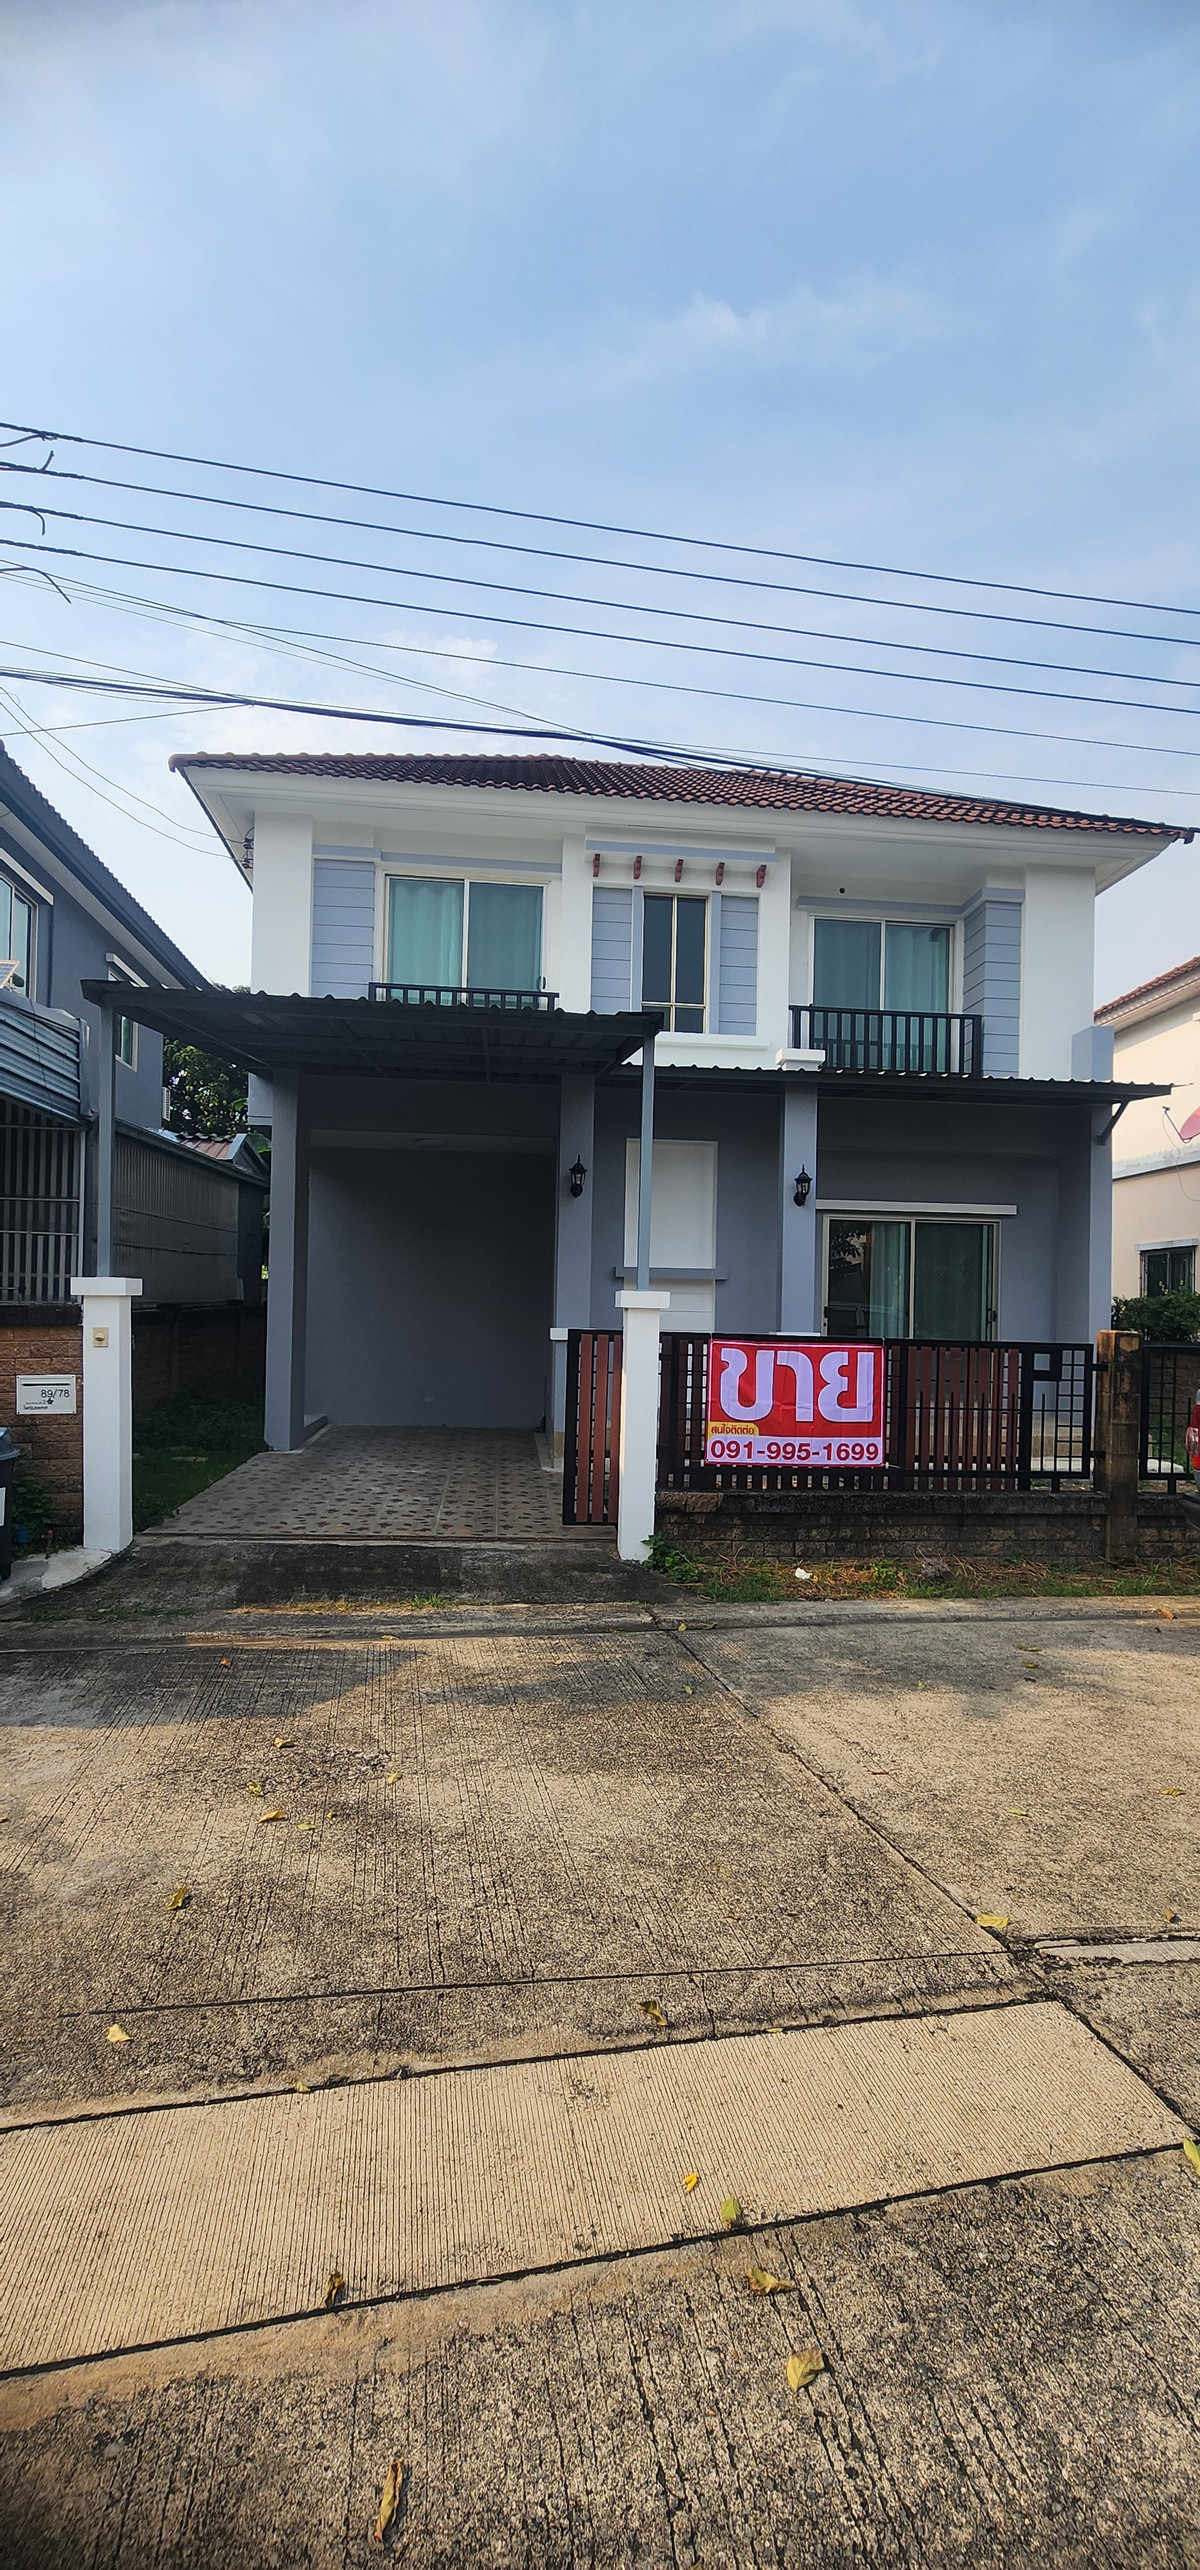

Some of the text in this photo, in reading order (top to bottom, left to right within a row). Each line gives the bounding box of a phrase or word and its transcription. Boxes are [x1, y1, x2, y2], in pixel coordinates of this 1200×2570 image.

[720, 1348, 874, 1422] ขาย
[40, 1389, 70, 1398] 89/78
[711, 1424, 754, 1435] สนใจติดต่อ
[710, 1440, 879, 1461] 091-995-1699
